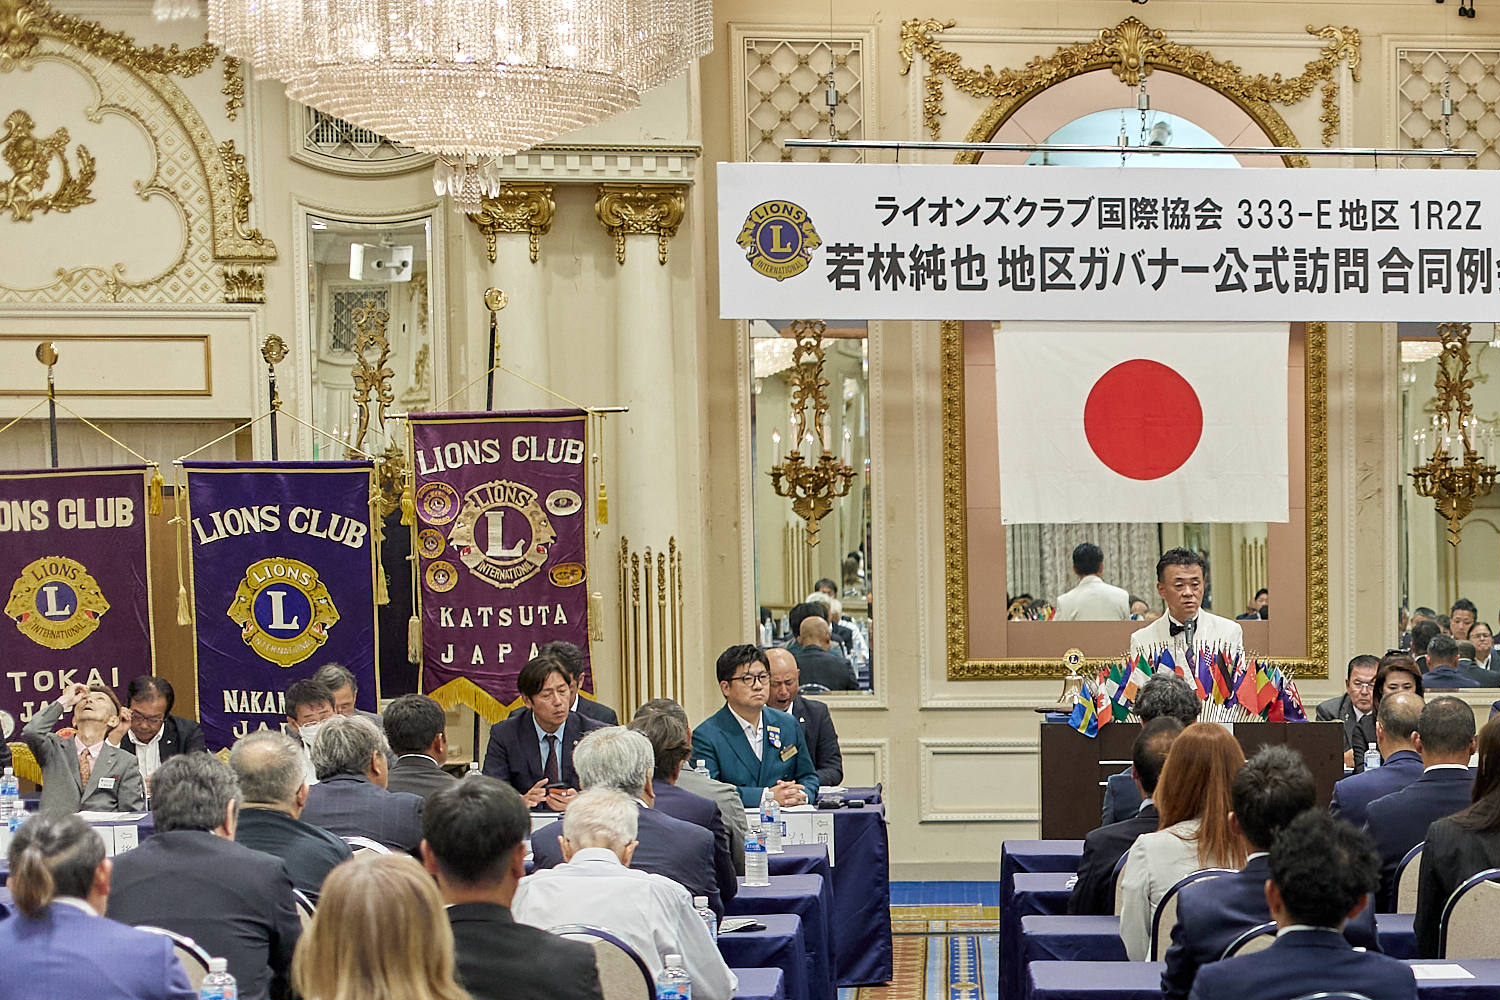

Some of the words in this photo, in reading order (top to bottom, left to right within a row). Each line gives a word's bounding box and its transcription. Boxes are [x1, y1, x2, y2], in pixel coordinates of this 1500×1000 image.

[754, 203, 803, 220] LIONS
[874, 195, 1223, 230] ライオンズクラブ国際協会
[1409, 200, 1482, 230] 1R2Z
[769, 225, 792, 253] L
[755, 259, 804, 275] INTERNATIONAL
[416, 438, 500, 475] LIONS
[512, 435, 585, 464] CLUB
[473, 485, 531, 509] LIONS
[57, 497, 134, 530] CLUB
[192, 505, 281, 546] LIONS
[288, 506, 368, 549] CLUB
[485, 510, 526, 557] L
[31, 562, 81, 582] LIONS
[252, 563, 311, 586] LIONS
[476, 560, 535, 581] INTERNATIONAL
[43, 586, 71, 617] L
[266, 591, 300, 630] L
[440, 604, 568, 628] KATSUTA
[31, 621, 87, 640] INTERNATIONAL
[254, 637, 316, 655] INTERNATIONAL
[6, 666, 119, 693] TOKAI
